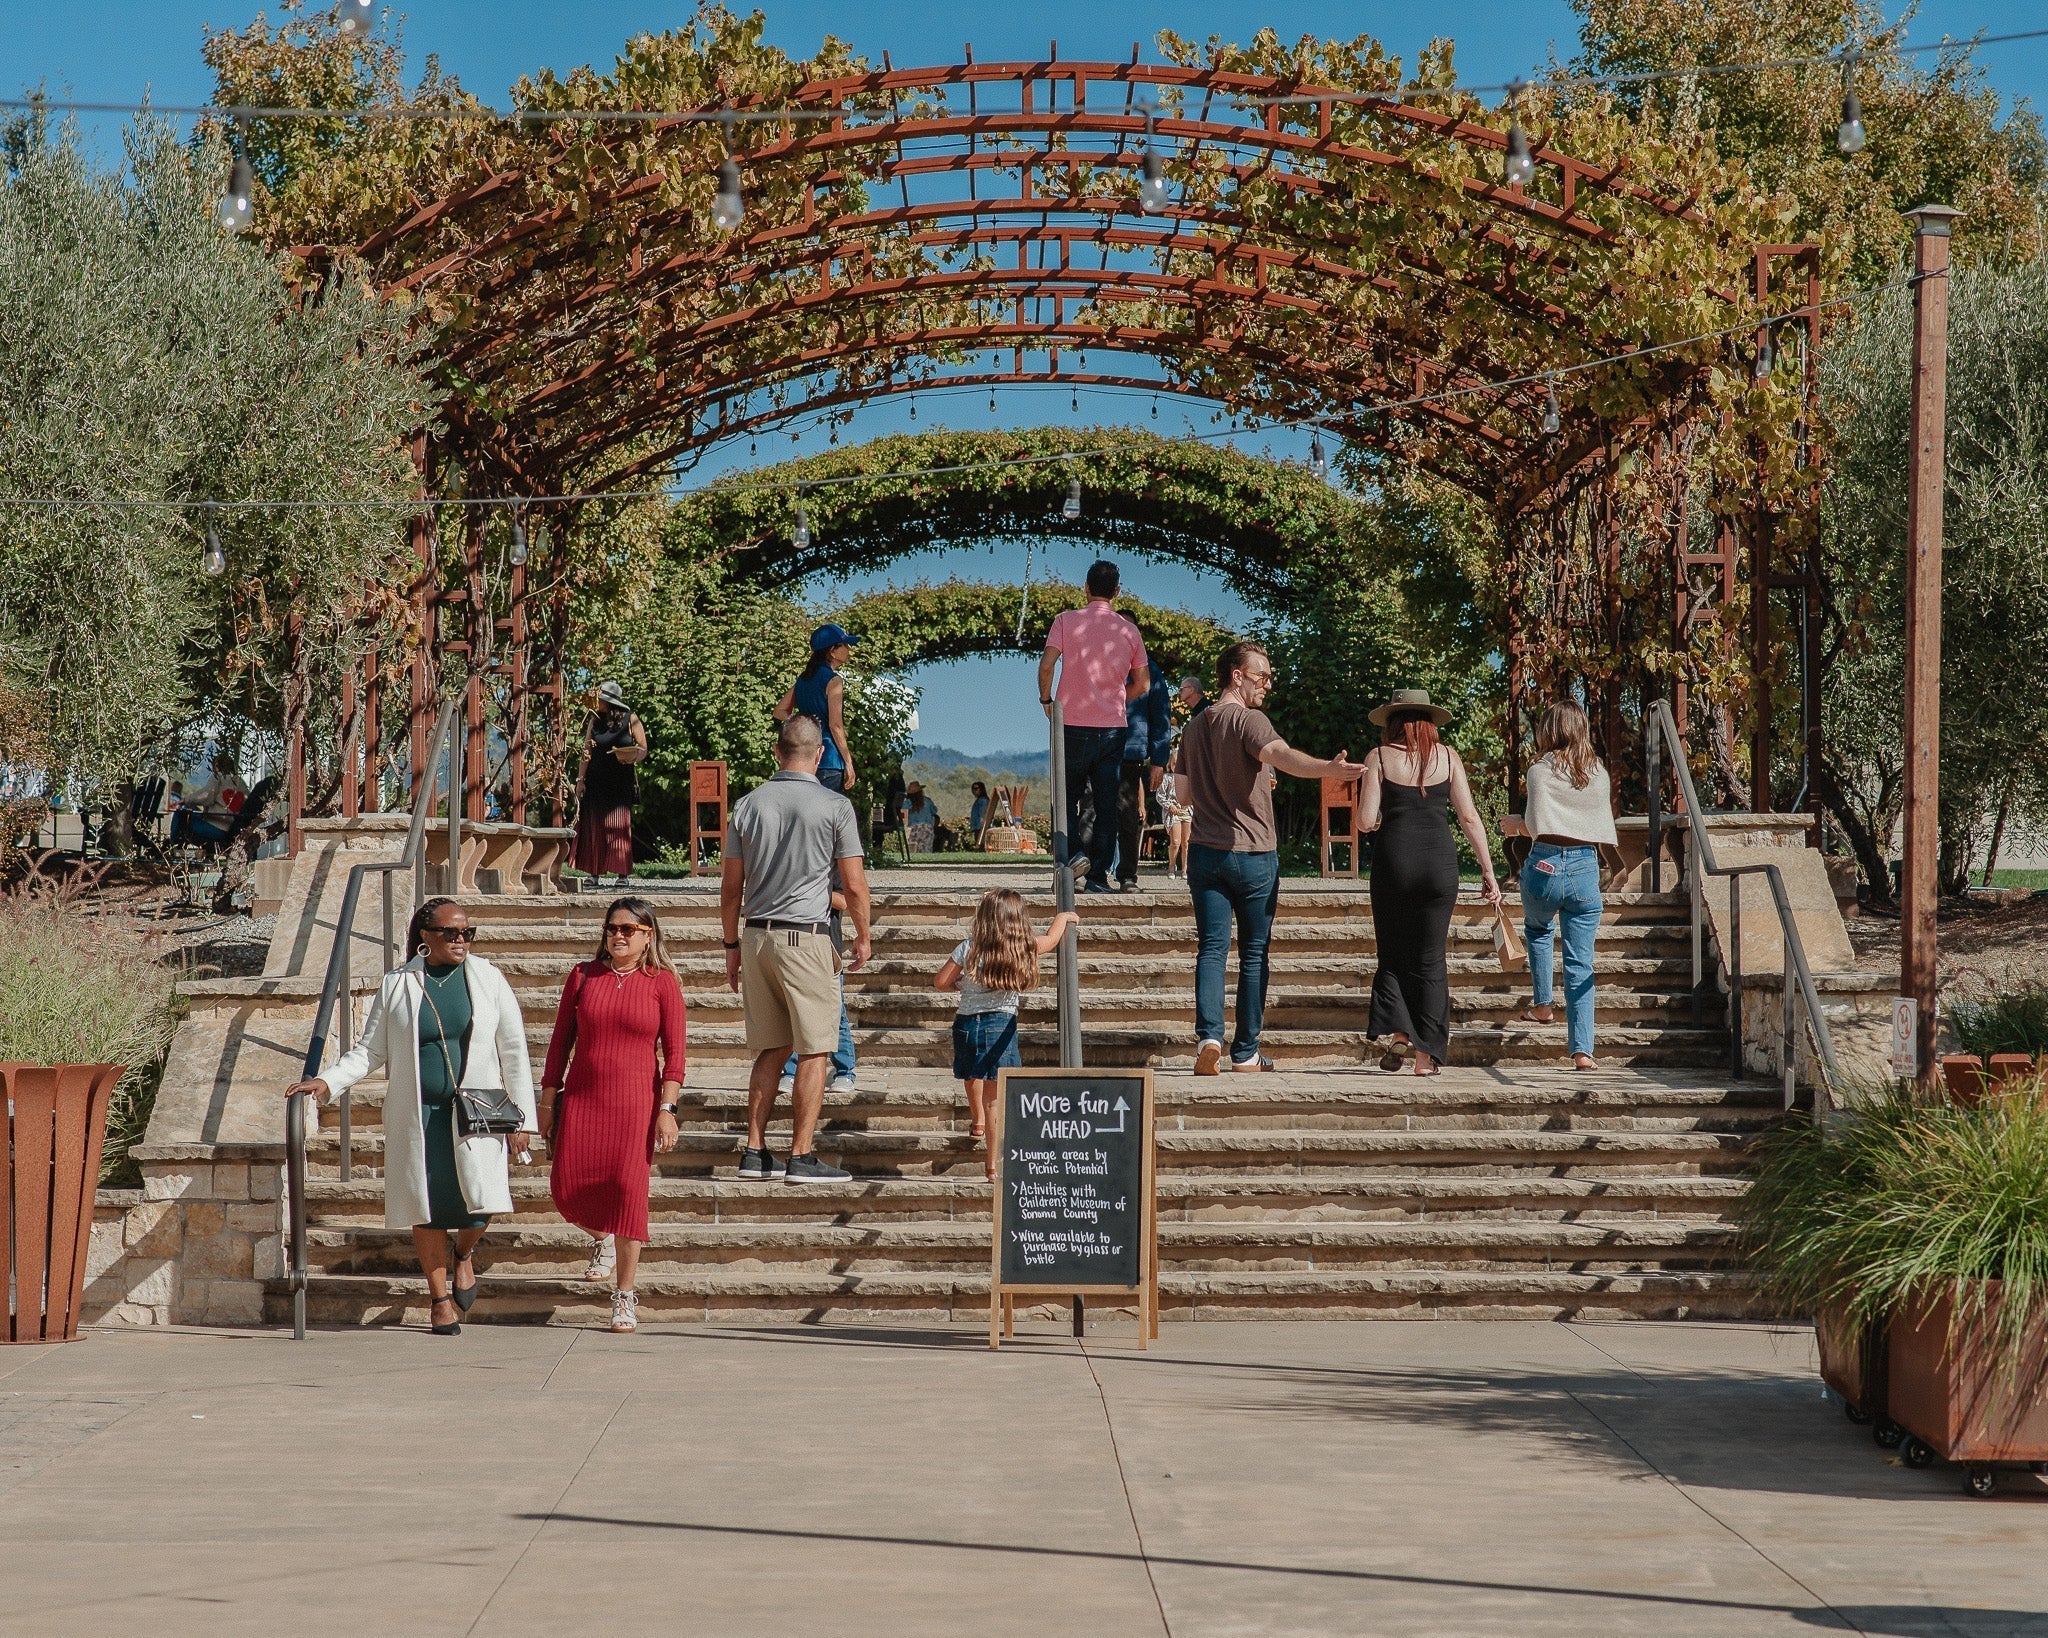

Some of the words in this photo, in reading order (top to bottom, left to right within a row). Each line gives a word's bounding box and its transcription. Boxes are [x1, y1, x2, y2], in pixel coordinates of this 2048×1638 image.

[1021, 1093, 1070, 1118] More
[1078, 1091, 1108, 1114] fun
[1041, 1120, 1091, 1139] AHEAD
[1020, 1149, 1056, 1164] Lounge
[1062, 1151, 1089, 1162] areas
[1095, 1149, 1107, 1165] by
[1029, 1162, 1059, 1174] Picnic
[1065, 1162, 1108, 1175] Potential
[1020, 1181, 1067, 1196] Activities
[1071, 1184, 1096, 1197] with
[1019, 1196, 1067, 1208] Children's
[1071, 1197, 1110, 1210] Museum
[1115, 1196, 1126, 1211] of
[1022, 1209, 1056, 1219] Sonoma
[1064, 1208, 1098, 1224] County
[1050, 1230, 1095, 1244] available
[1099, 1232, 1110, 1243] to
[1071, 1242, 1084, 1256] by
[1084, 1244, 1108, 1257] glass
[1112, 1246, 1123, 1254] or
[1024, 1253, 1055, 1265] bottle
